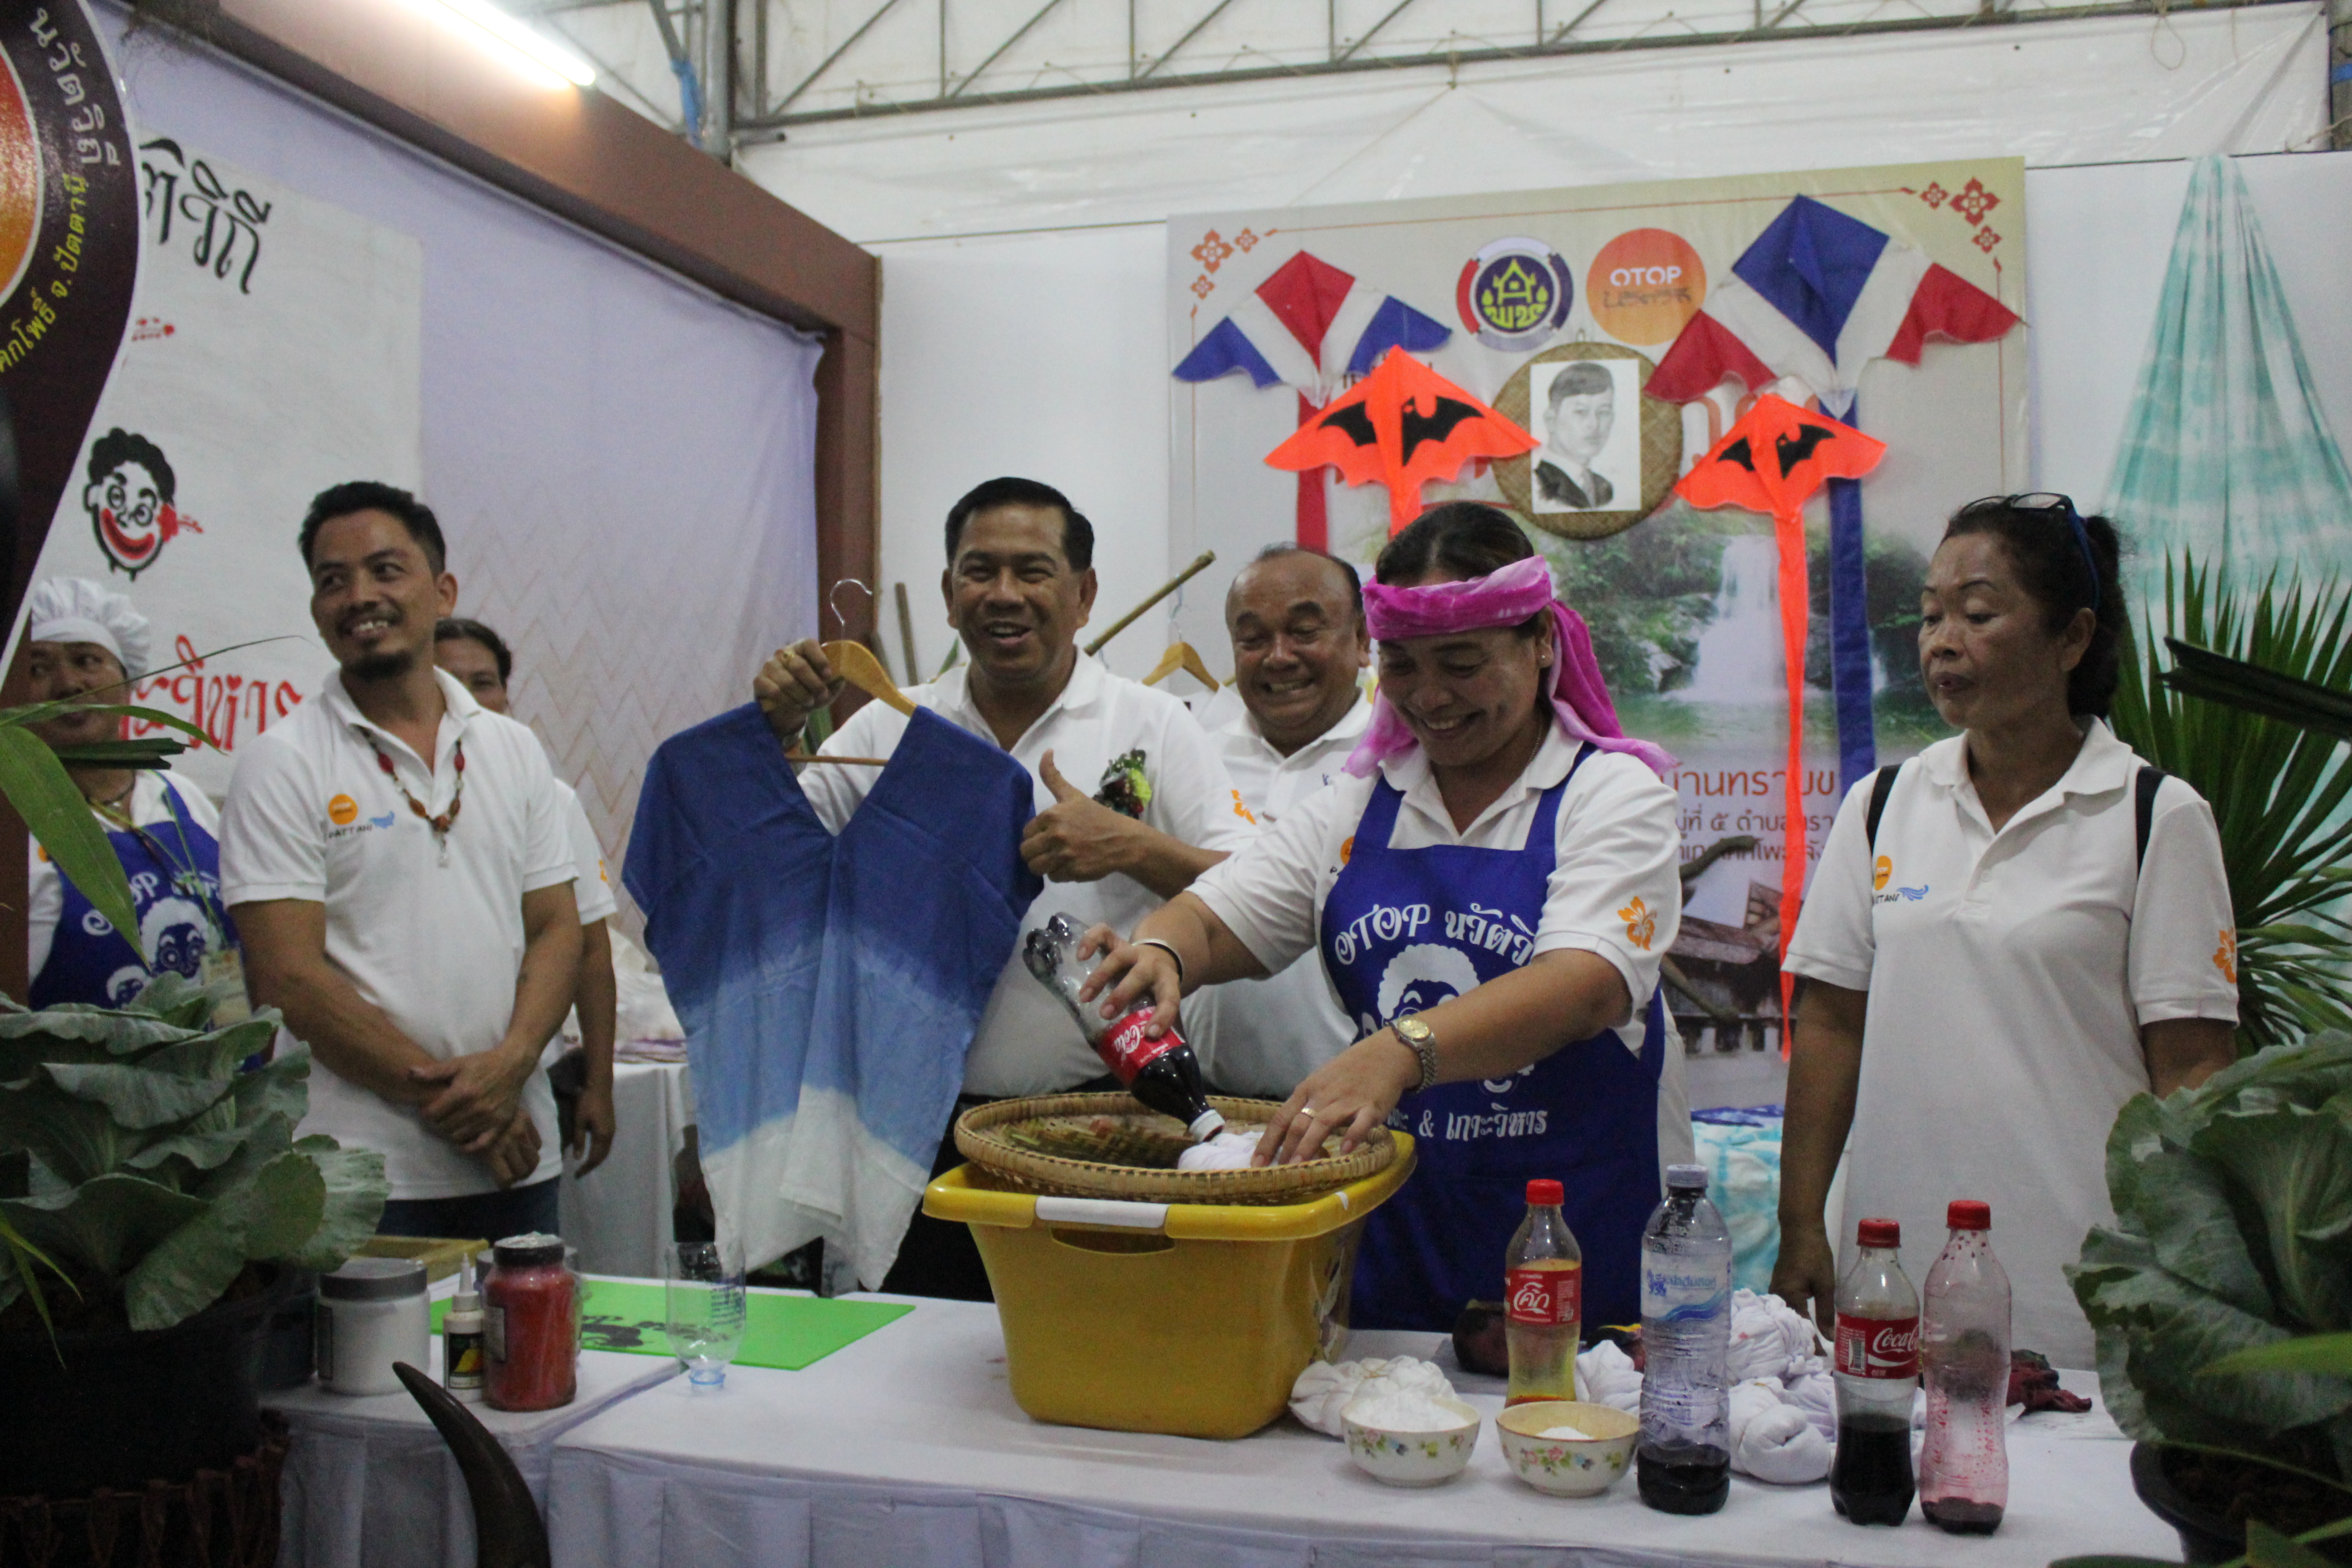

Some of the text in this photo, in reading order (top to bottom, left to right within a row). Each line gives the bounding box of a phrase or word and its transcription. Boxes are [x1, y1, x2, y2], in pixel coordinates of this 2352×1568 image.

[29, 8, 121, 166] นวัตวิถี
[1610, 266, 1682, 286] OTOP
[1335, 903, 1431, 965] OTOP
[1445, 902, 1535, 966] นวัตวิ
[1418, 1109, 1434, 1138] &
[1446, 1102, 1548, 1142] เกาะวิหาร
